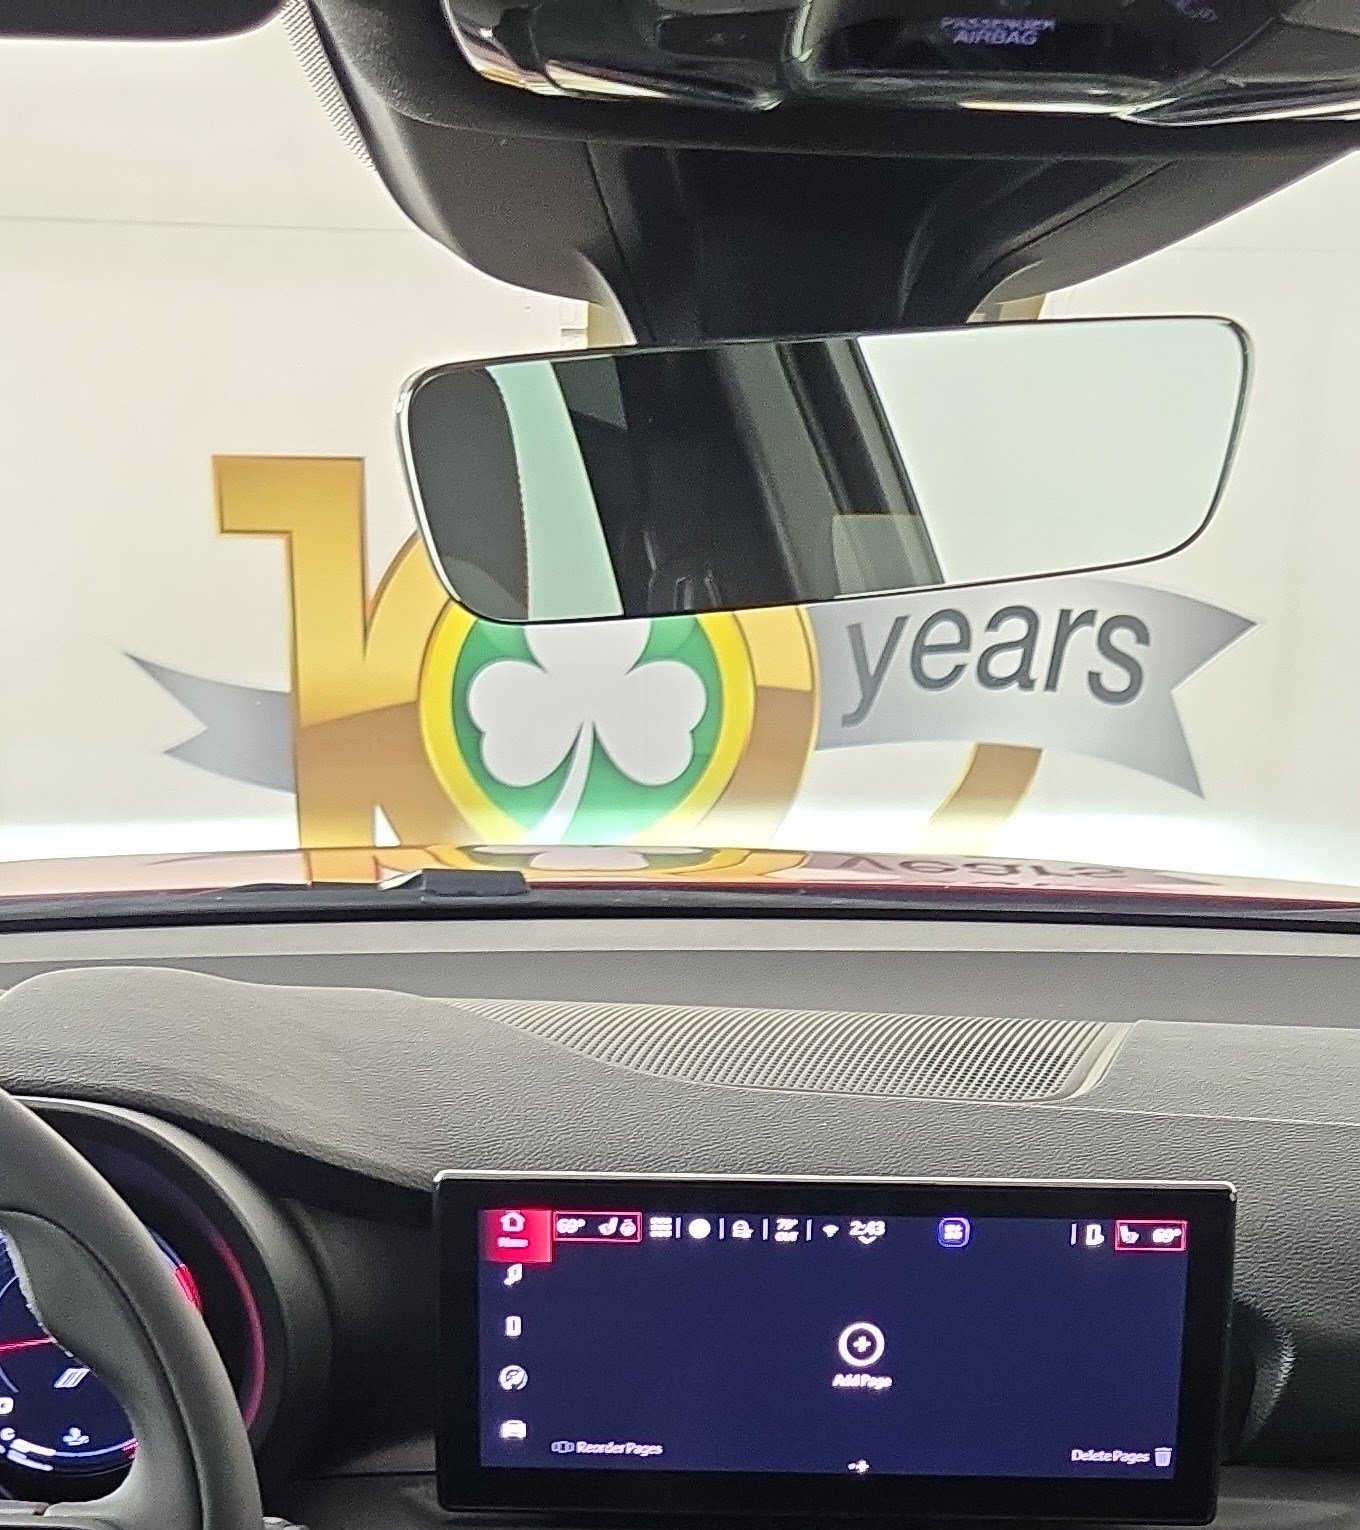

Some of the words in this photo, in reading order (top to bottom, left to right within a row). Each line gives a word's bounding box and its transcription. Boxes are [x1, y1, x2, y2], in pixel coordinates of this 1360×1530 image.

[940, 17, 1056, 31] PASSENGER
[953, 29, 1037, 46] AIRBAG
[839, 603, 1152, 729] years
[832, 1374, 861, 1387] Add
[860, 1374, 892, 1390] Page
[576, 1441, 626, 1454] Reorder
[625, 1442, 664, 1457] Pages
[1071, 1449, 1112, 1462] Delete
[1112, 1450, 1151, 1465] Pages
